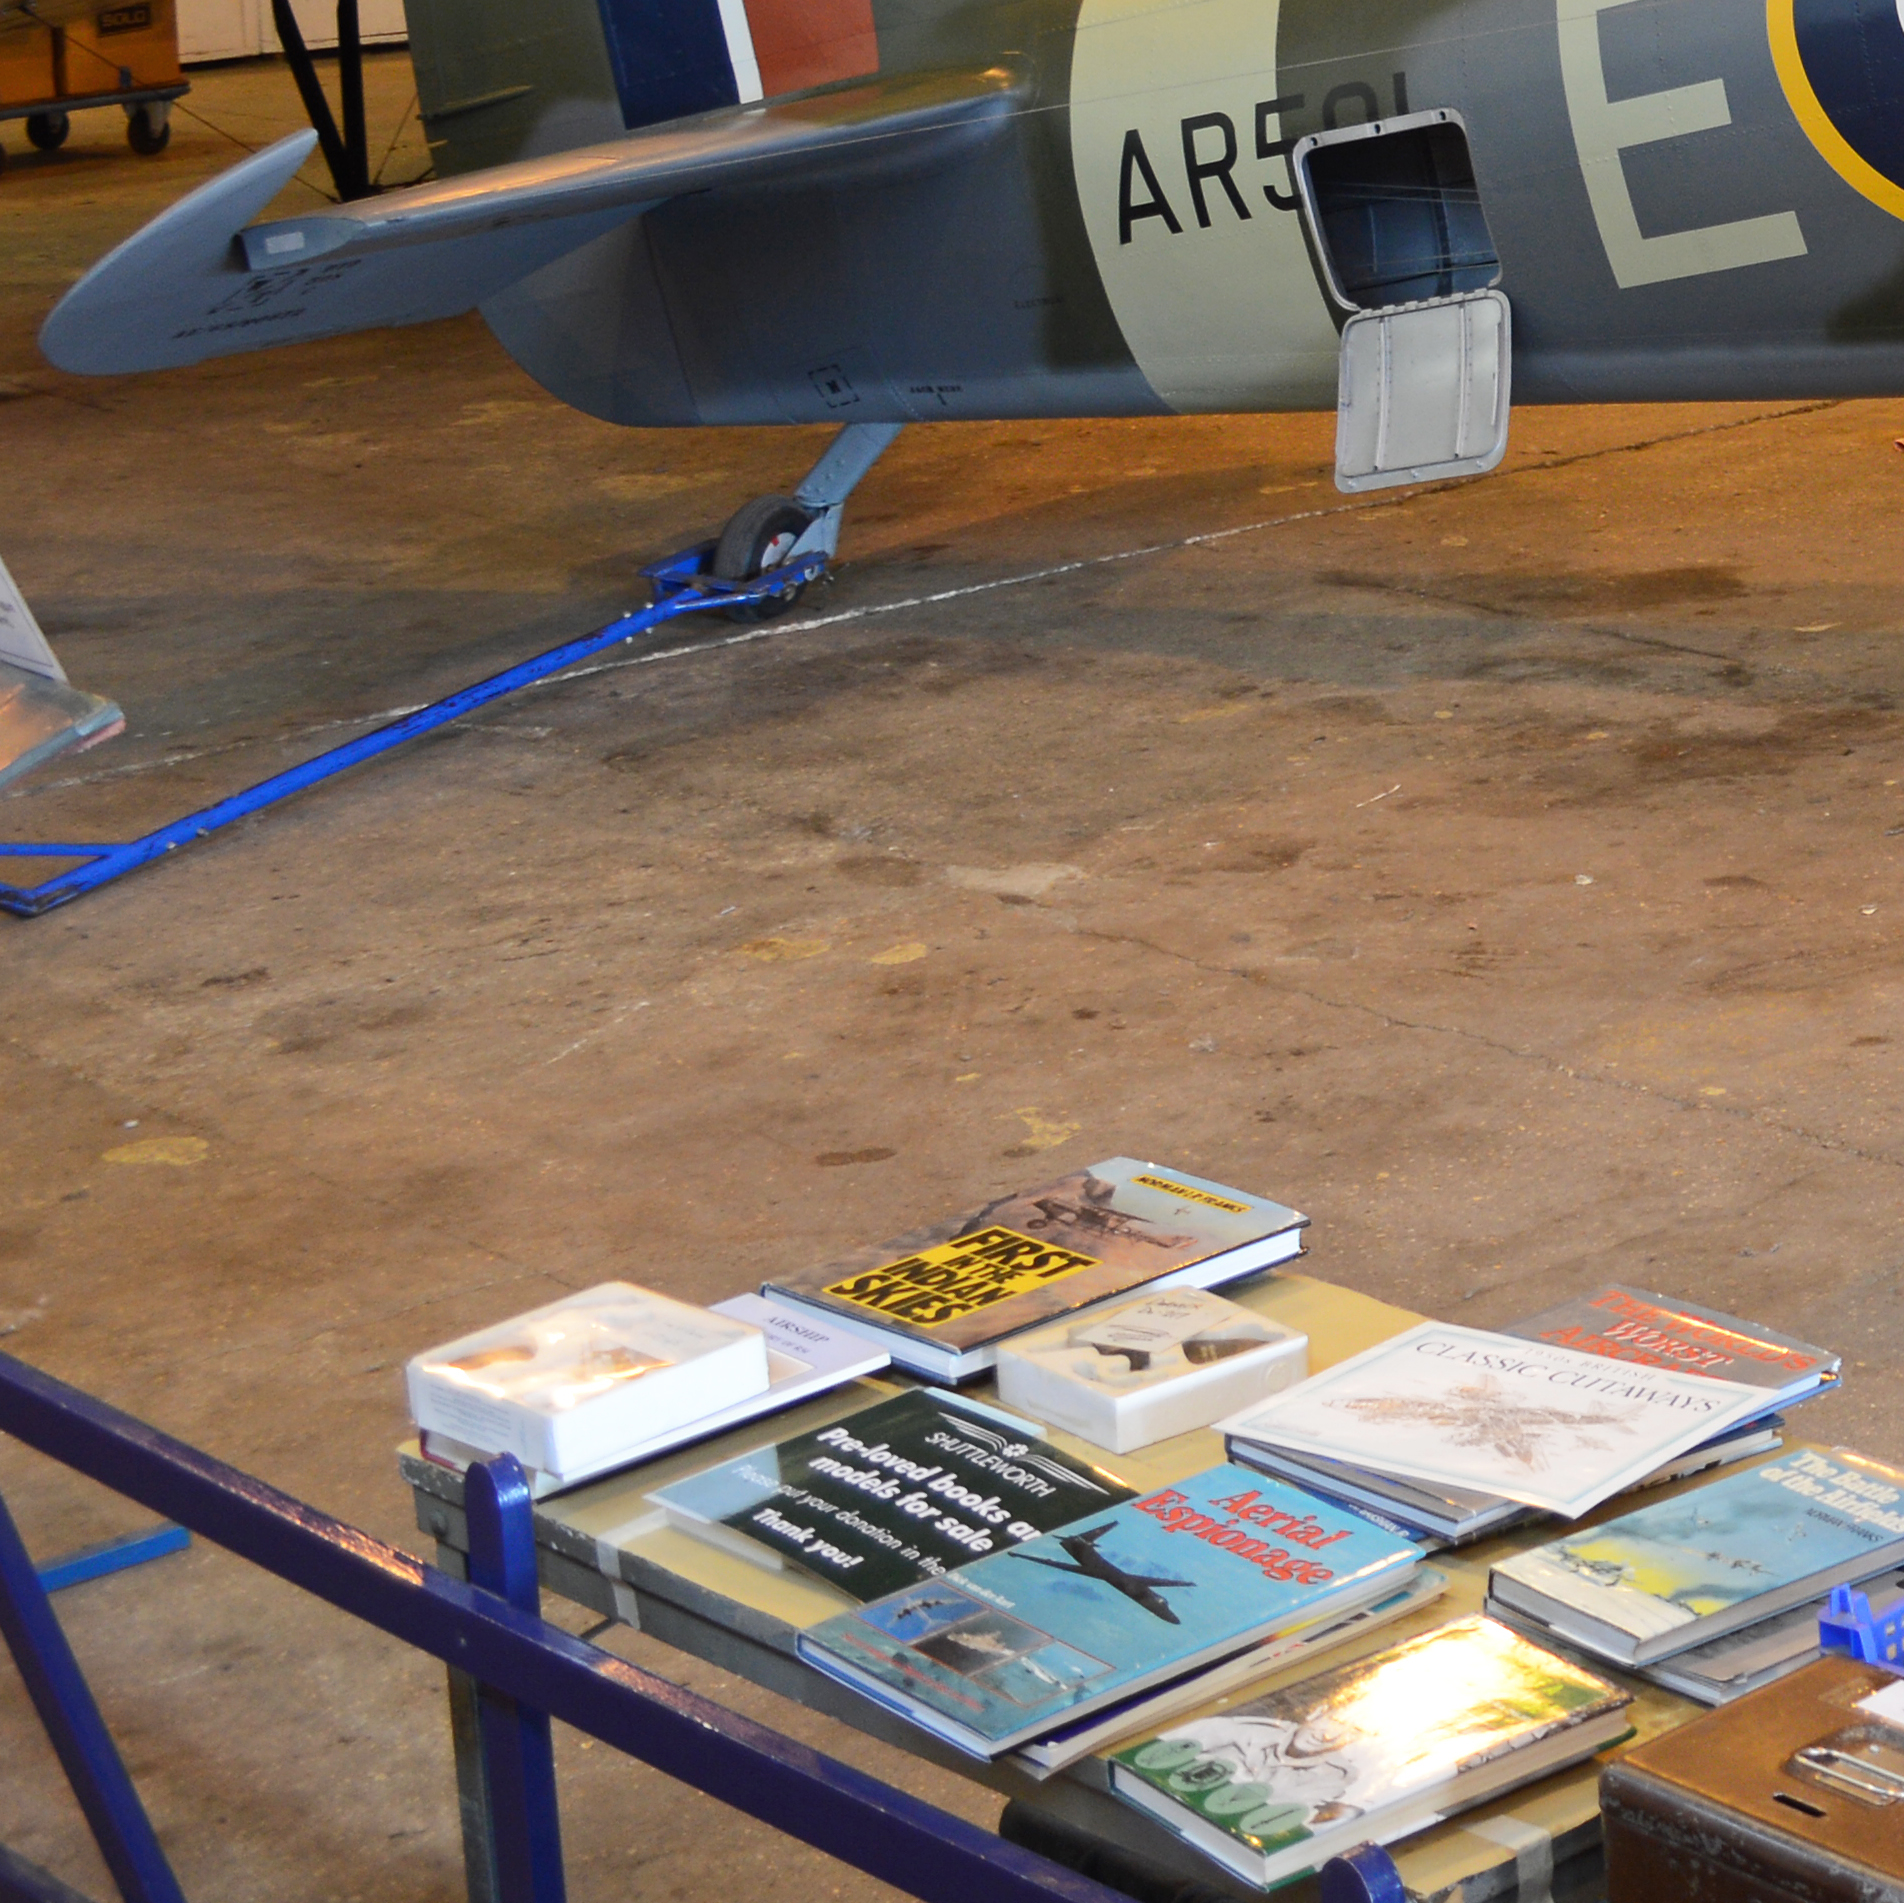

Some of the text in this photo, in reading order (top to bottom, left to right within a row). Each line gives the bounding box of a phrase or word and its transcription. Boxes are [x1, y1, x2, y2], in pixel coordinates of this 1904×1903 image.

[939, 1254, 1025, 1284] IN THE
[950, 1228, 1097, 1279] FIRST
[829, 1274, 975, 1324] SKIES
[881, 1257, 1021, 1307] INDIAN
[1589, 1289, 1660, 1324] THE
[1579, 1358, 1658, 1382] BRITISH
[1603, 1321, 1735, 1370] WORST
[1415, 1340, 1722, 1414] CLASSIC CUTAWAYS
[816, 1426, 943, 1483] Pre-loved
[927, 1473, 1013, 1524] books
[924, 1431, 1057, 1498] SHUTTLEWORTH
[1759, 1467, 1799, 1483] of
[1780, 1473, 1825, 1497] the
[1789, 1451, 1901, 1505] The Battle
[808, 1456, 994, 1553] models for sale
[1207, 1488, 1355, 1553] Aerial
[752, 1507, 865, 1569] Thank you!
[795, 1493, 840, 1514] your
[834, 1510, 903, 1550] donation
[900, 1544, 921, 1561] in
[917, 1555, 947, 1577] the
[1130, 1489, 1335, 1586] Espionage
